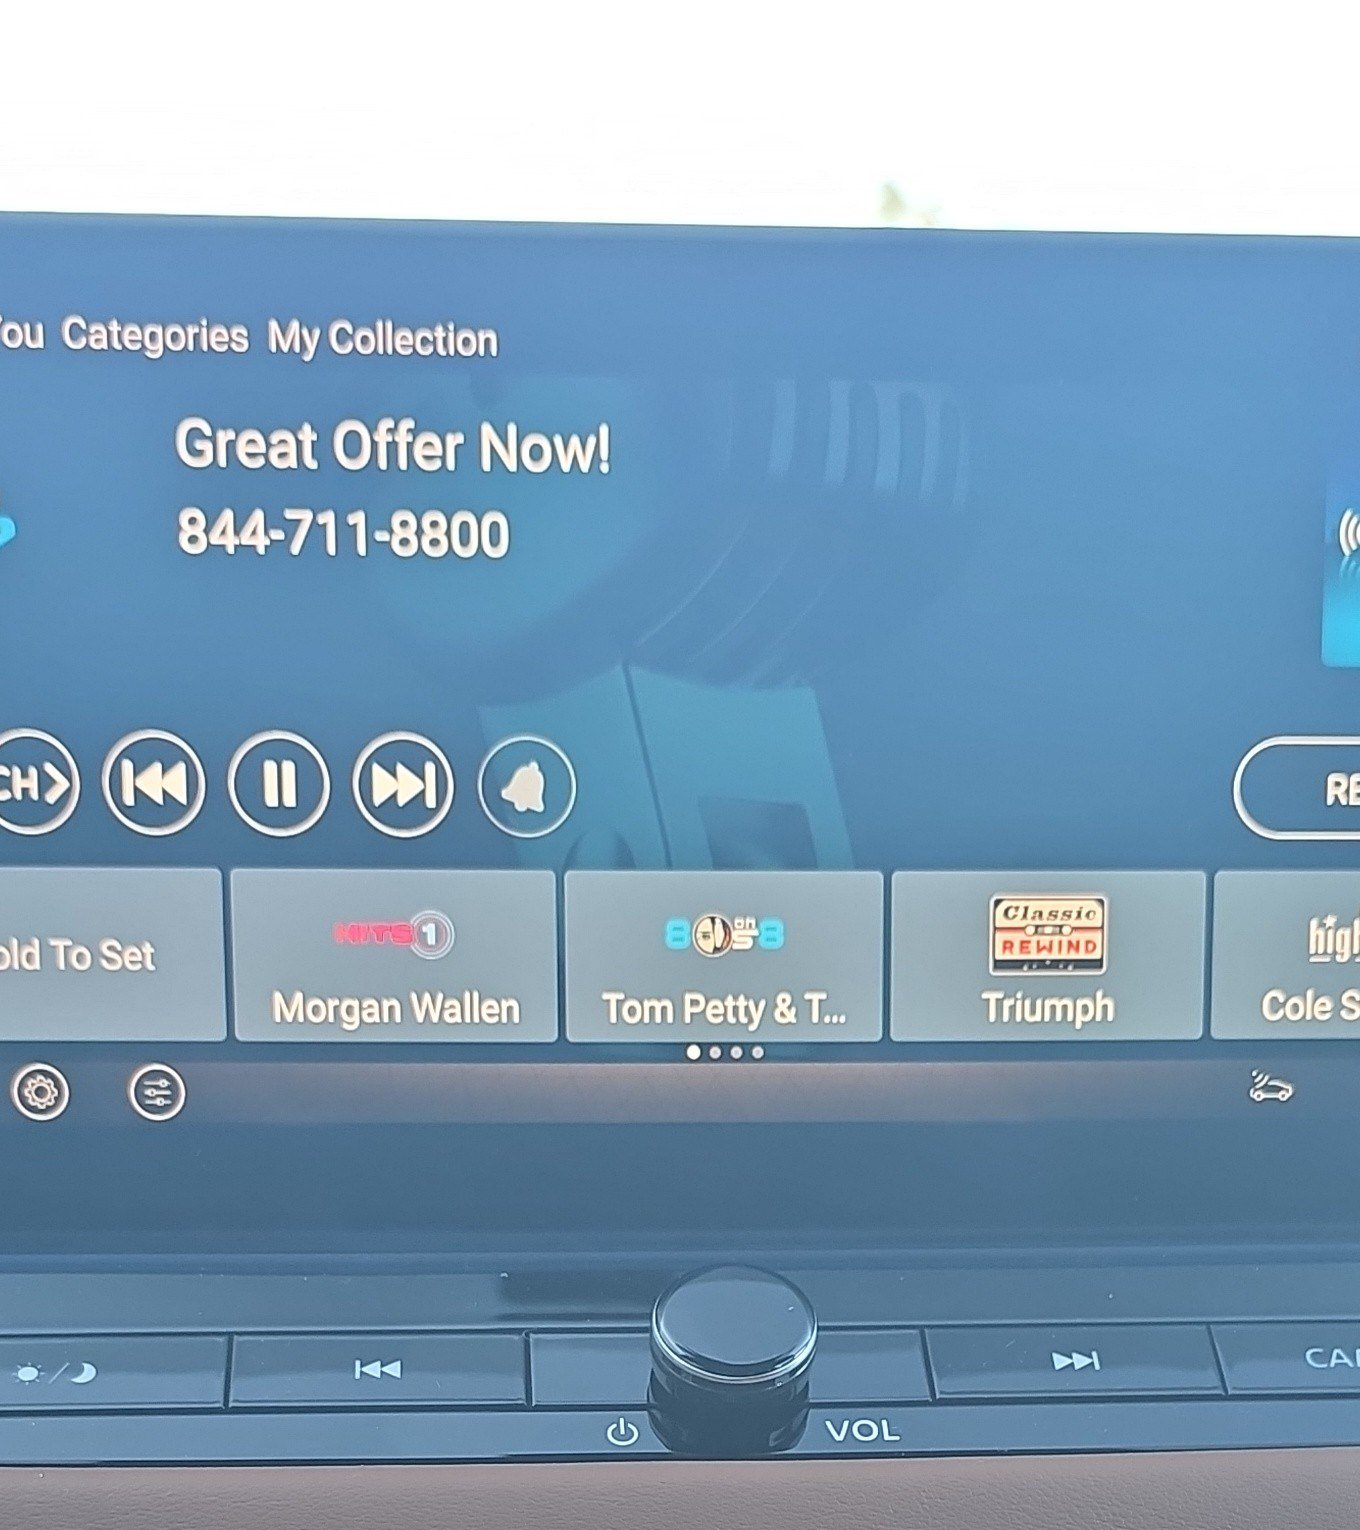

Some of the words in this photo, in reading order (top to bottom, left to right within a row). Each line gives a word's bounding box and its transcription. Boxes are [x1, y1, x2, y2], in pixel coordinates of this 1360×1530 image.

[61, 316, 249, 358] Categories
[268, 320, 322, 362] My
[328, 320, 499, 357] Collection
[175, 416, 317, 470] Great
[332, 418, 464, 472] Offer
[478, 422, 611, 474] Now!
[177, 507, 510, 559] 844-711-8800
[1002, 905, 1097, 921] Classic
[422, 922, 436, 946] 1
[1002, 939, 1097, 955] REWIND
[49, 940, 92, 971] To
[99, 939, 156, 972] Set
[273, 991, 402, 1029] Morgan
[409, 991, 521, 1025] Wallen
[602, 991, 674, 1025] Tom
[684, 992, 766, 1031] Petty
[772, 993, 797, 1025] &
[982, 990, 1115, 1029] Triumph
[1261, 988, 1332, 1022] Cole
[825, 1420, 901, 1442] VOL
